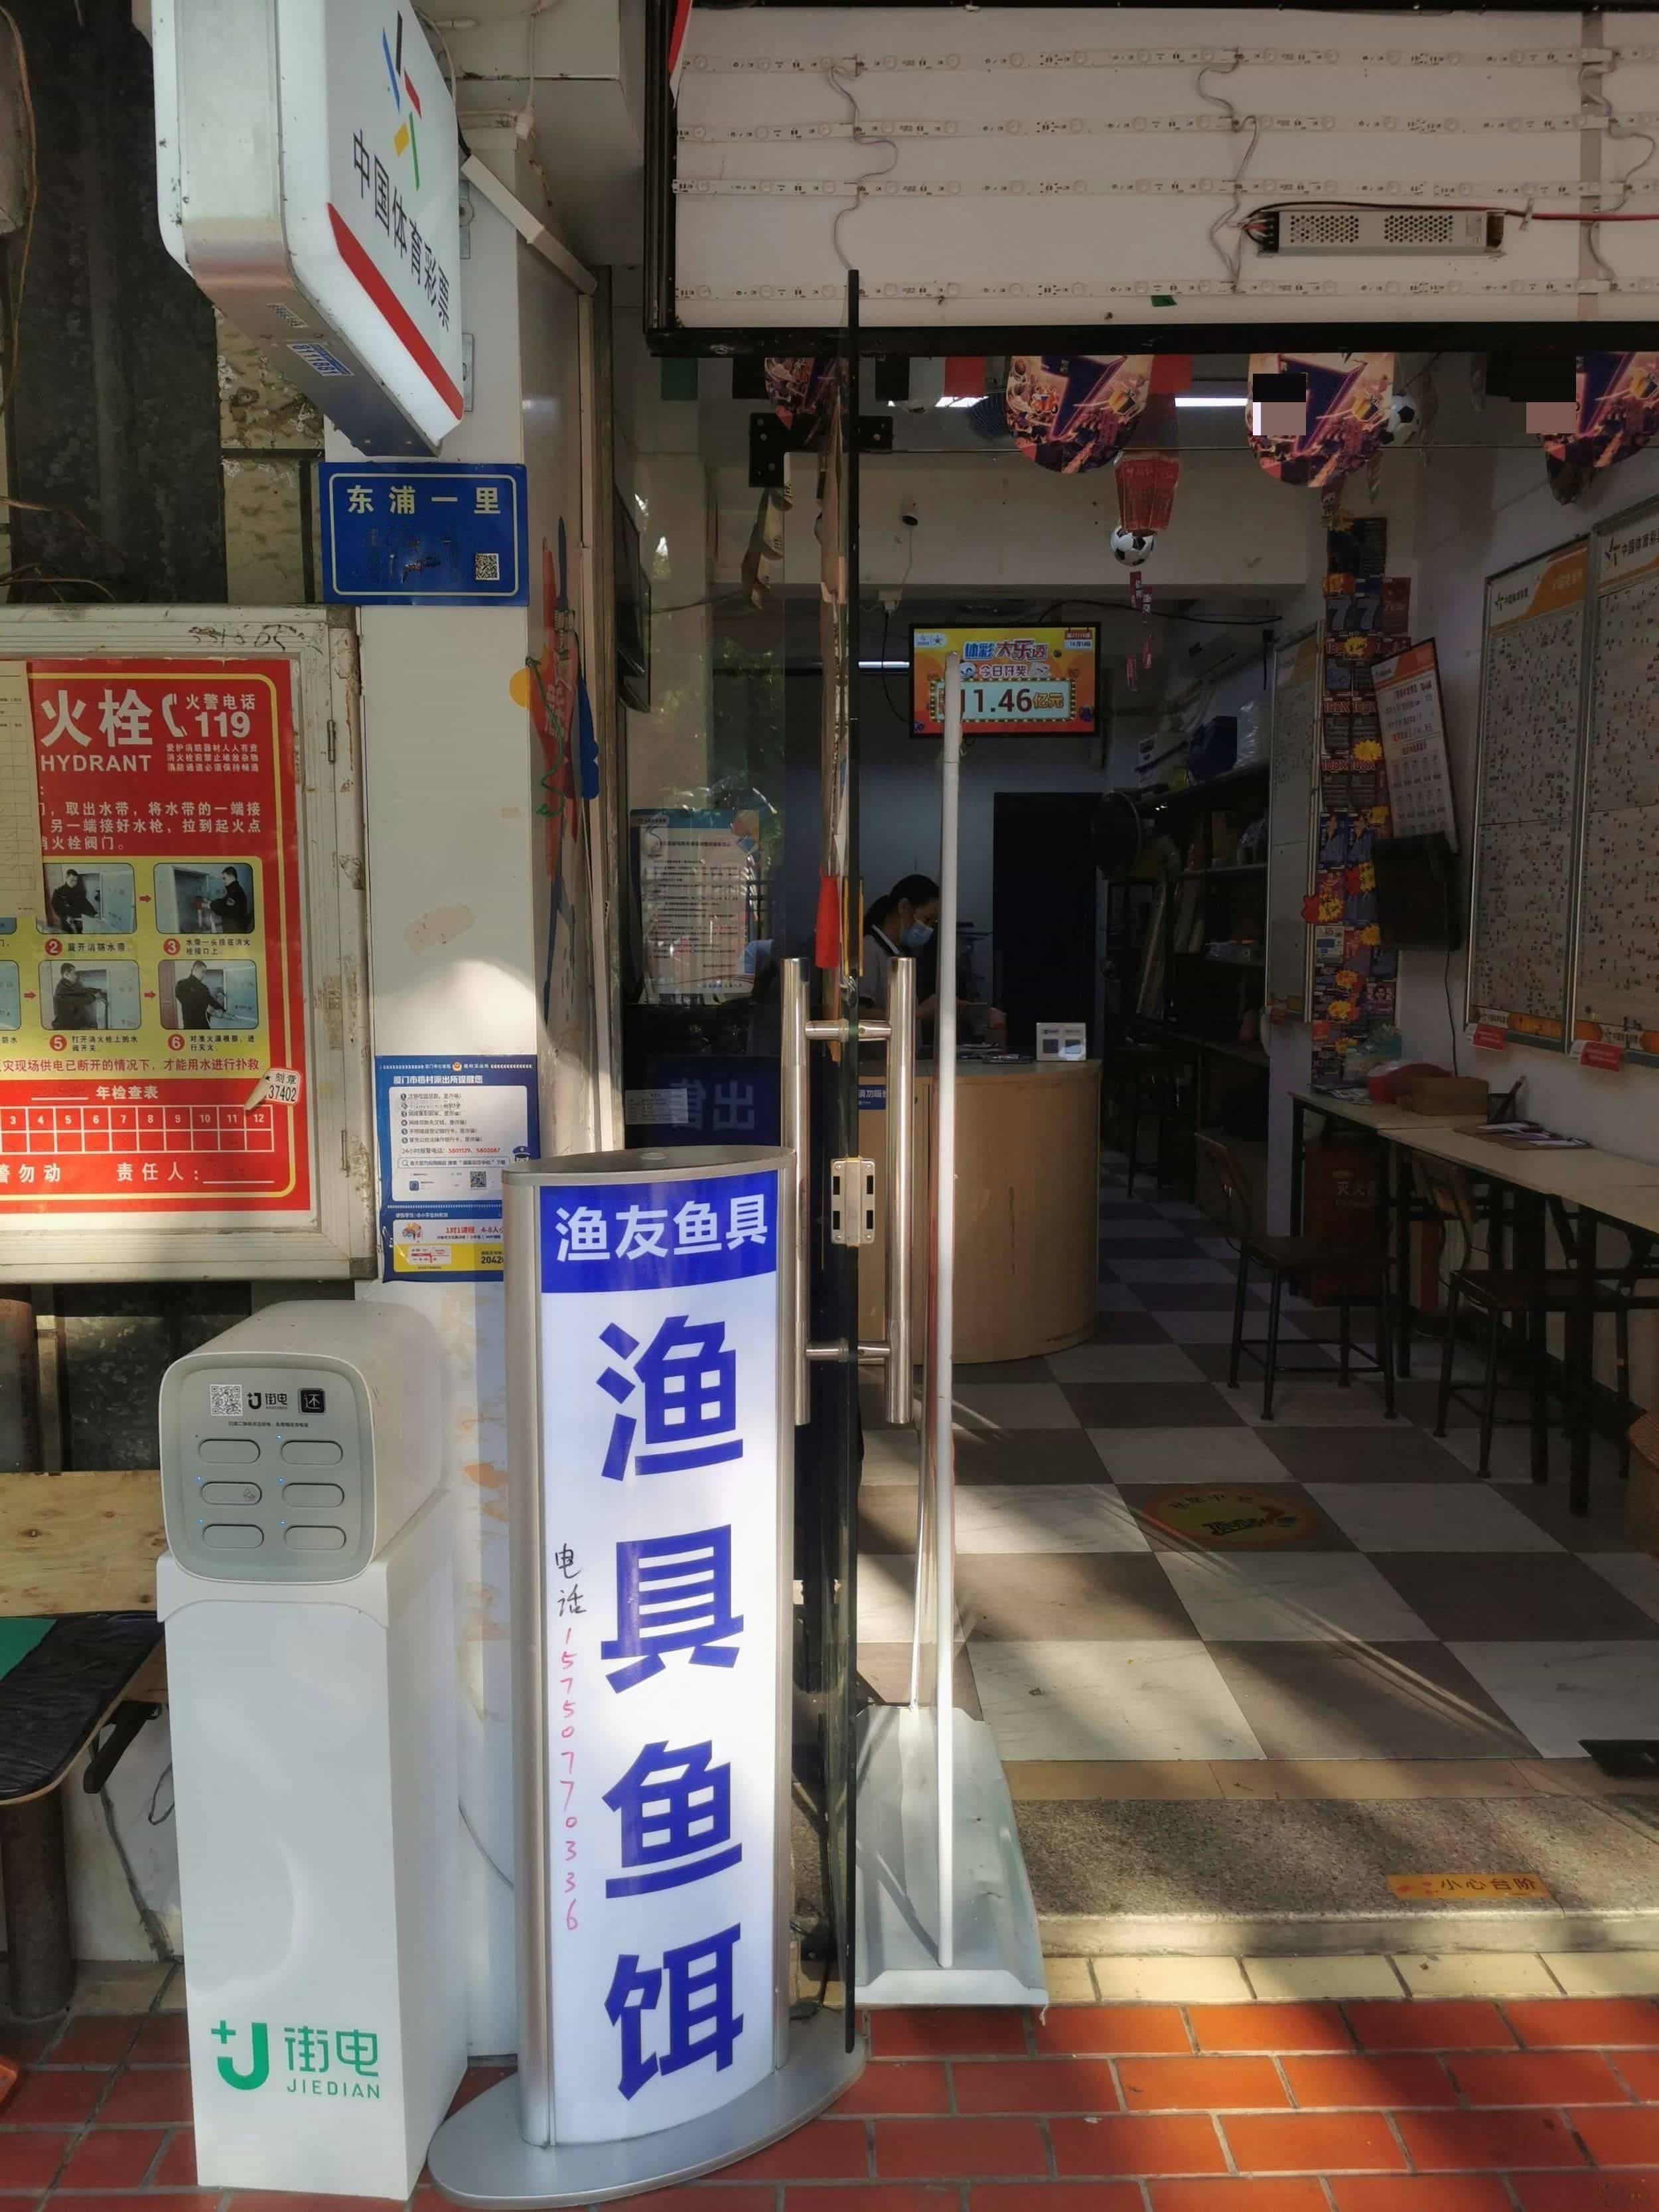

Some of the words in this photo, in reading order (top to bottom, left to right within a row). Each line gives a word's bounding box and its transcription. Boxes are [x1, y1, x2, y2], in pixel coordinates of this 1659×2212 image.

[352, 128, 449, 334] 中国体育彩票
[347, 485, 502, 516] 东浦一里
[964, 639, 1048, 660] 体彩大乐透
[979, 665, 1029, 678] 今日开奖
[186, 693, 256, 710] 火警电话
[41, 689, 153, 748] 火栓
[195, 712, 250, 738] 119
[41, 755, 151, 772] HYDRANT
[50, 819, 261, 834] 另一端接好水枪，拉到起火点
[0, 1059, 263, 1073] 灾现场供电已断开的情况下，才能用水进行扑救。
[96, 1086, 159, 1100] 年检查表
[10, 1114, 17, 1124] 3
[37, 1114, 44, 1124] 4
[64, 1114, 72, 1124] 5
[92, 1114, 100, 1124] 6
[120, 1114, 127, 1124] 7
[147, 1114, 154, 1124] 8
[175, 1114, 181, 1124] 9
[200, 1114, 211, 1124] 10
[226, 1114, 238, 1124] 11
[253, 1114, 264, 1124] 12
[116, 1162, 198, 1181] 责任人：
[555, 1193, 768, 1262] 渔友鱼具
[265, 1393, 287, 1406] 街电
[554, 1543, 587, 1617] 电话
[596, 1315, 745, 2101] 渔具鱼饵
[559, 1627, 581, 1932] 15750770336
[1440, 1876, 1538, 1893] 小心台阶
[283, 2026, 379, 2077] 街电
[287, 2079, 380, 2099] JIEDIAN
